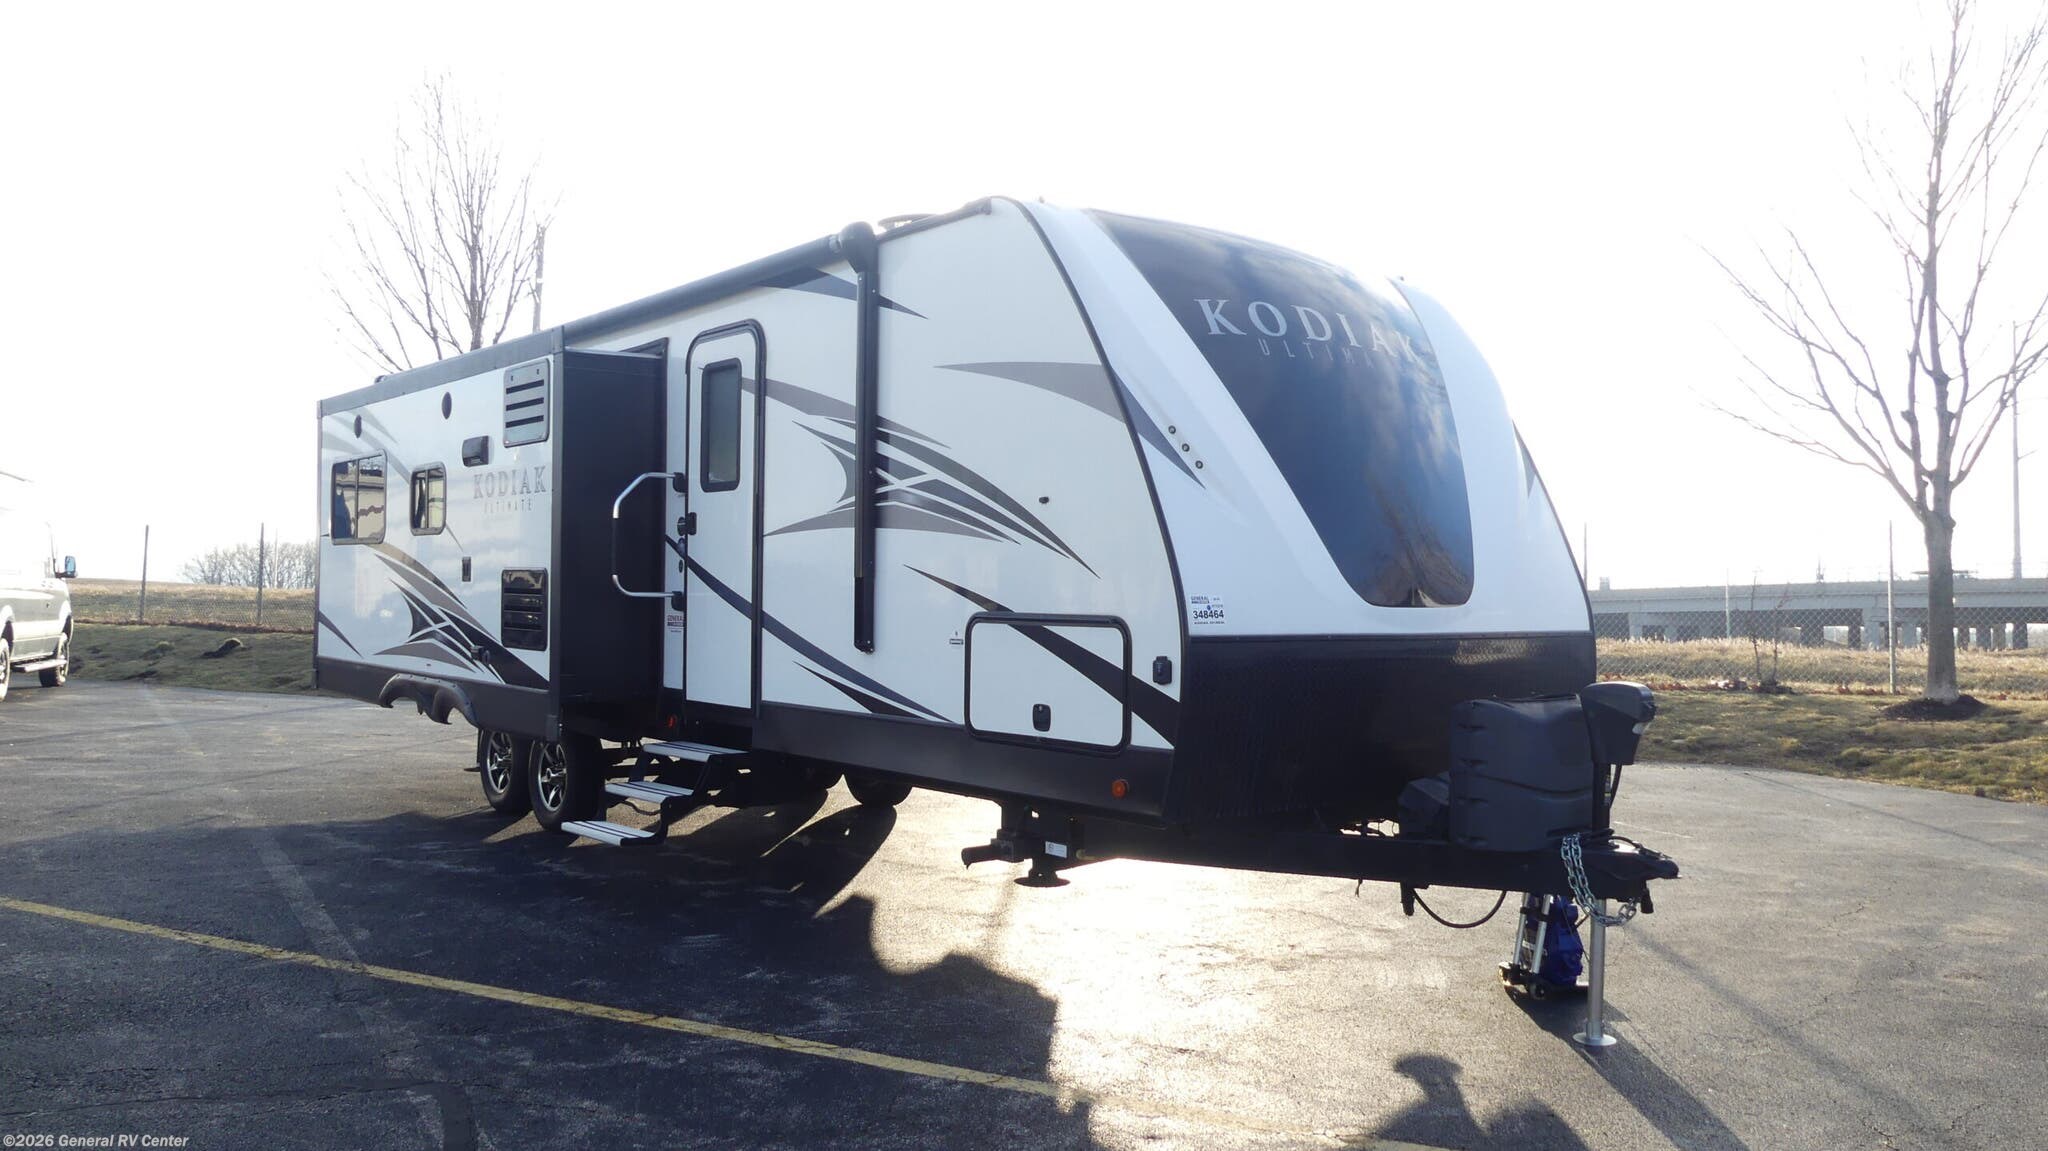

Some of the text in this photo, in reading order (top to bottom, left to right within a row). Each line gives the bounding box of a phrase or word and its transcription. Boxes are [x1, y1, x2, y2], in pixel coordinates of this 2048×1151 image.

[1194, 299, 1426, 369] KODIAK
[473, 466, 546, 499] KODIAK
[1192, 610, 1225, 619] 348464
